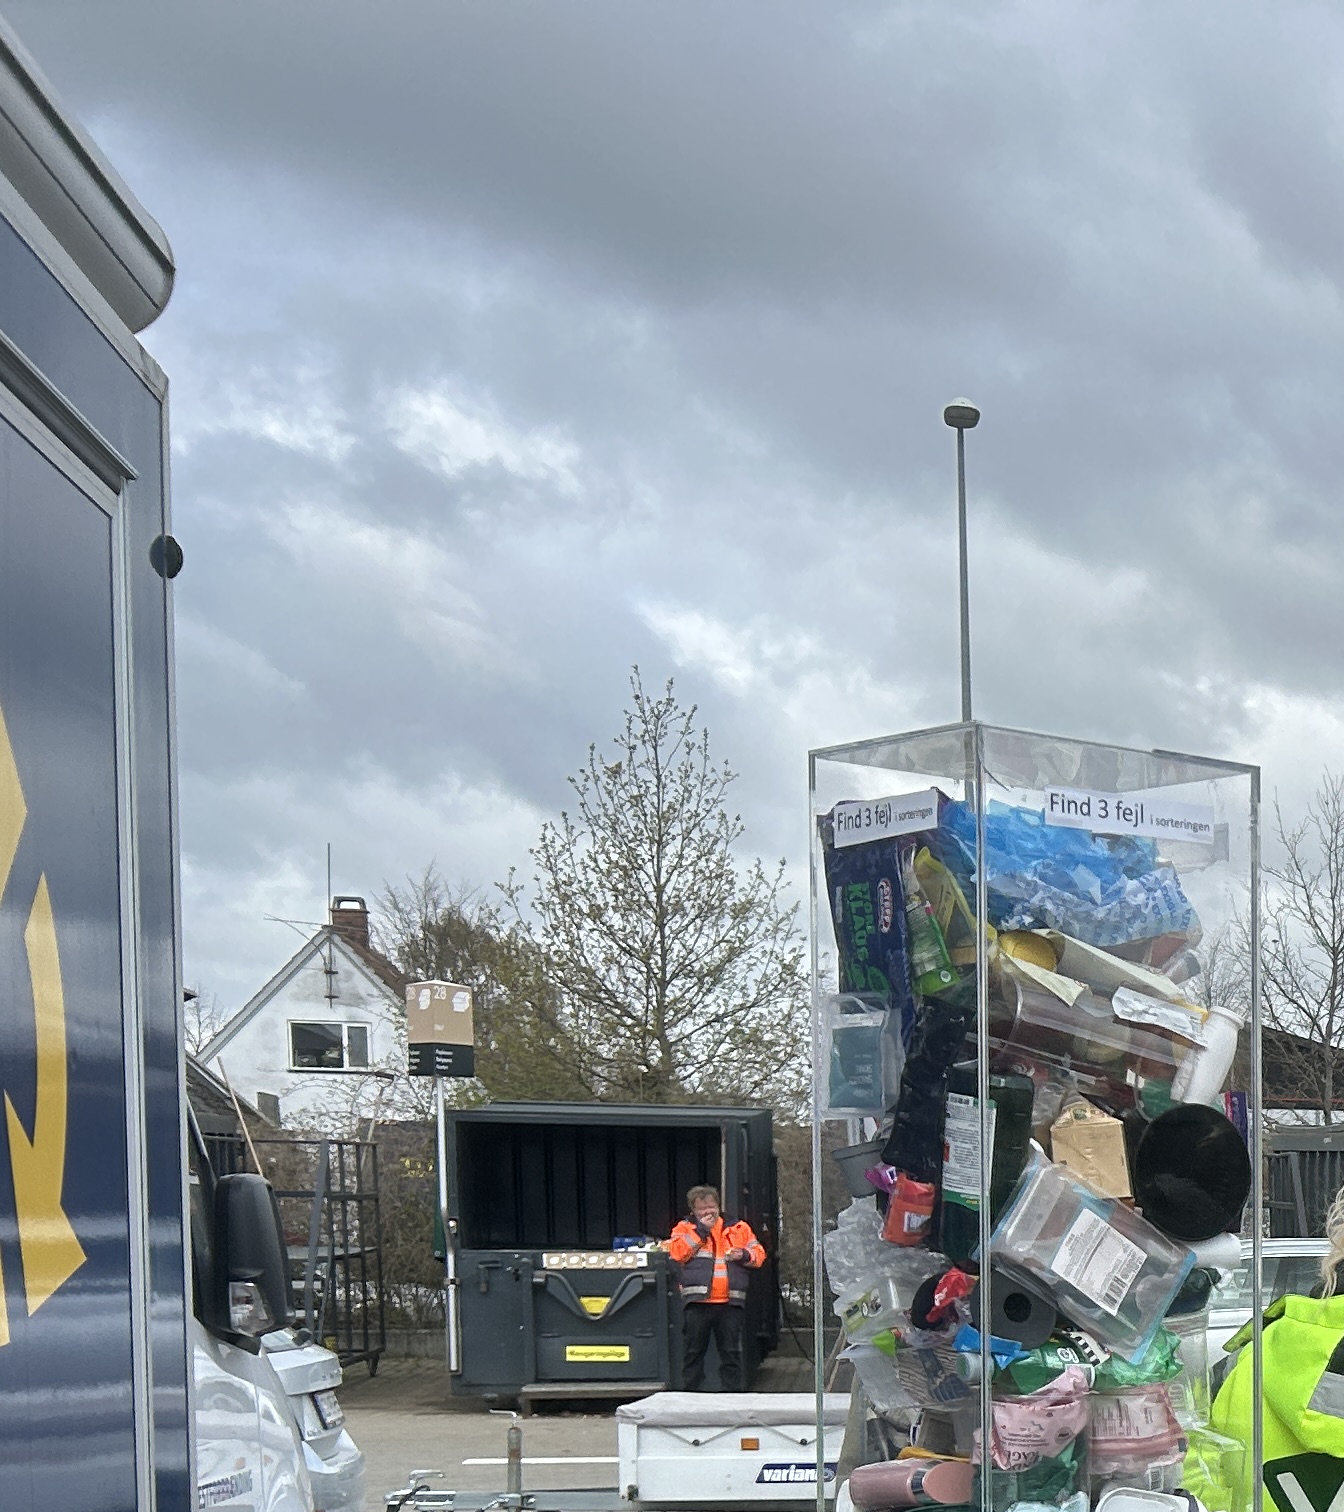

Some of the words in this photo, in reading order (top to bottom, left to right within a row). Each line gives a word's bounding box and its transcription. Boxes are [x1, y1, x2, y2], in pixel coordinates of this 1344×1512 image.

[837, 808, 862, 832] Find
[865, 807, 872, 828] 3
[875, 802, 892, 829] fejl
[1050, 792, 1091, 818] Find
[1098, 799, 1109, 819] 3
[1115, 800, 1145, 828] fejl
[1155, 815, 1210, 833] sorteringen
[433, 985, 447, 1000] 28
